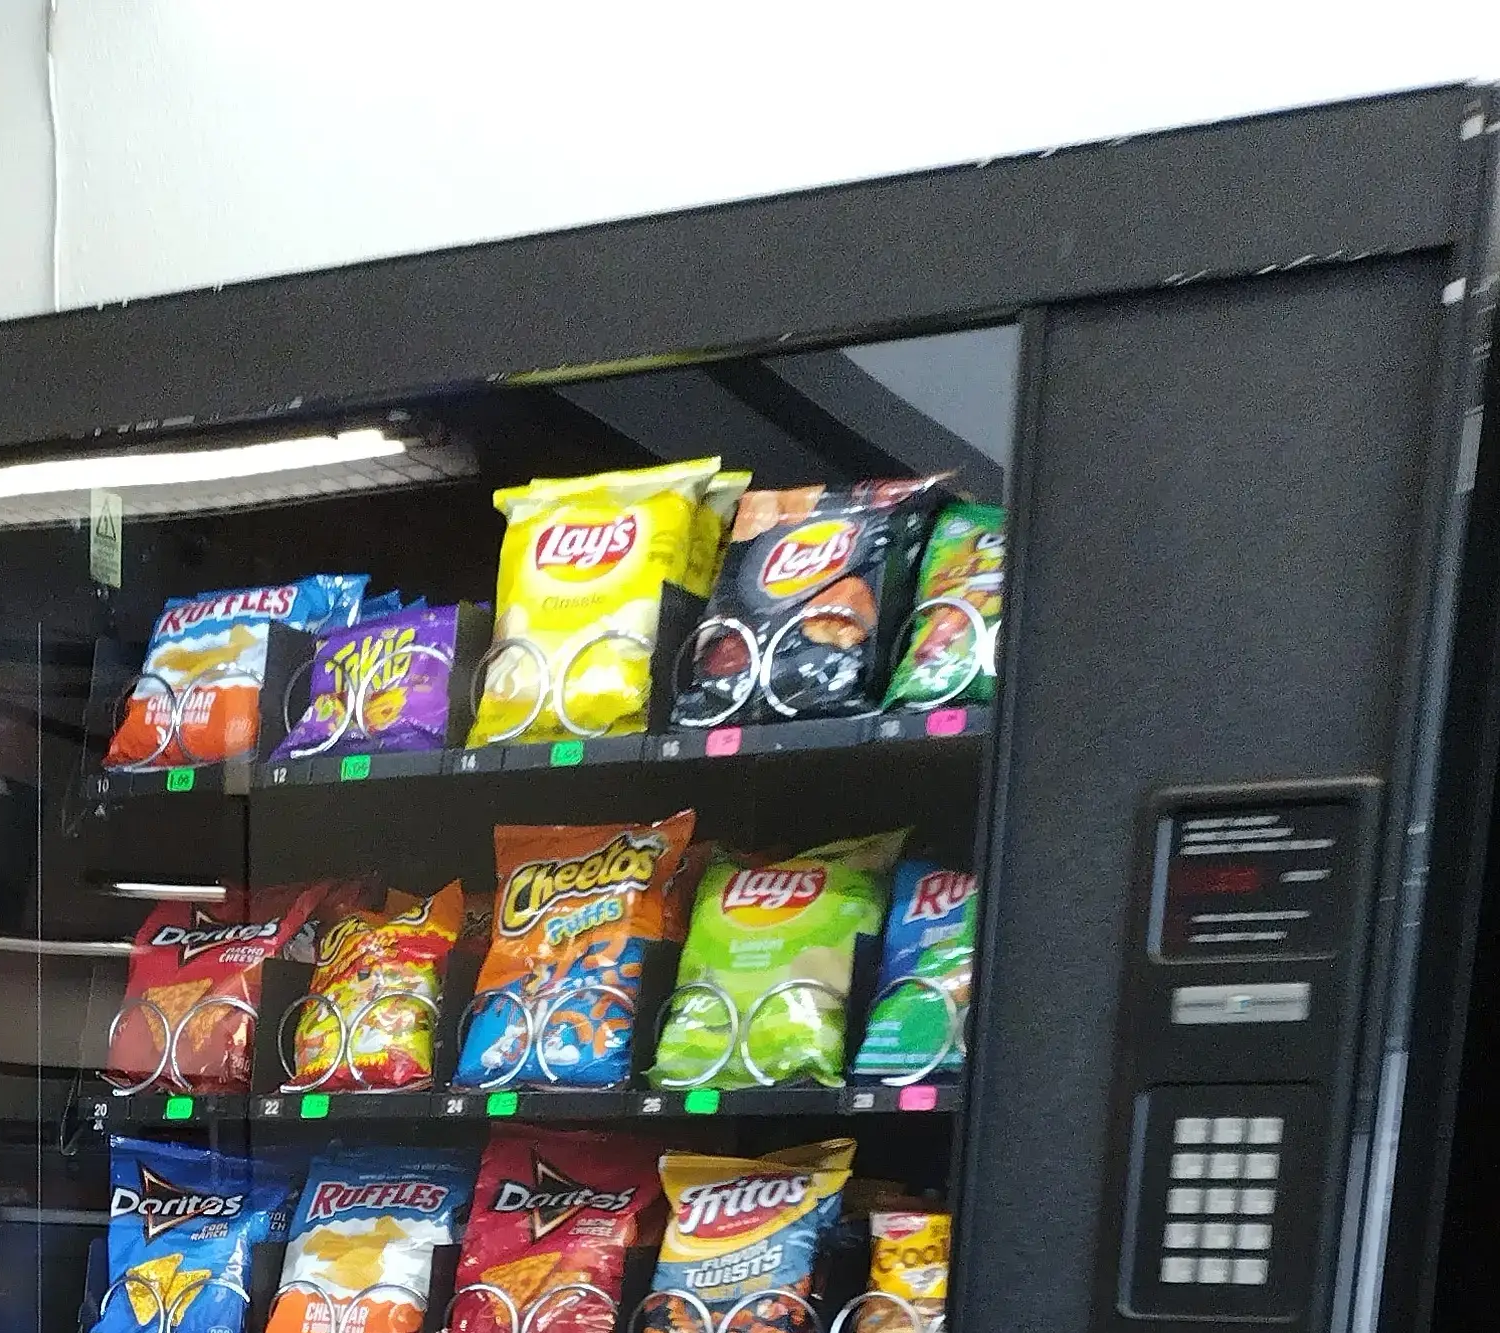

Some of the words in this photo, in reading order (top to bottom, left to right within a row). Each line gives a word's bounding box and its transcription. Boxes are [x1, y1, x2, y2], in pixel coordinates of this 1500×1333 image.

[537, 514, 637, 571] Lay's
[762, 524, 861, 585] Lay's
[96, 778, 109, 792] 10
[273, 768, 286, 783] 12
[501, 834, 656, 930] Cheetos
[152, 917, 280, 947] Doritos
[93, 1102, 108, 1117] 20
[264, 1102, 279, 1116] 22
[110, 1186, 244, 1218] Doritos
[310, 1183, 447, 1219] RUFFLES
[494, 1183, 638, 1213] Doritos
[677, 1174, 809, 1234] Fritos
[190, 1230, 229, 1241] RANCH
[202, 1222, 229, 1232] COOL
[682, 1244, 784, 1289] TWISTS
